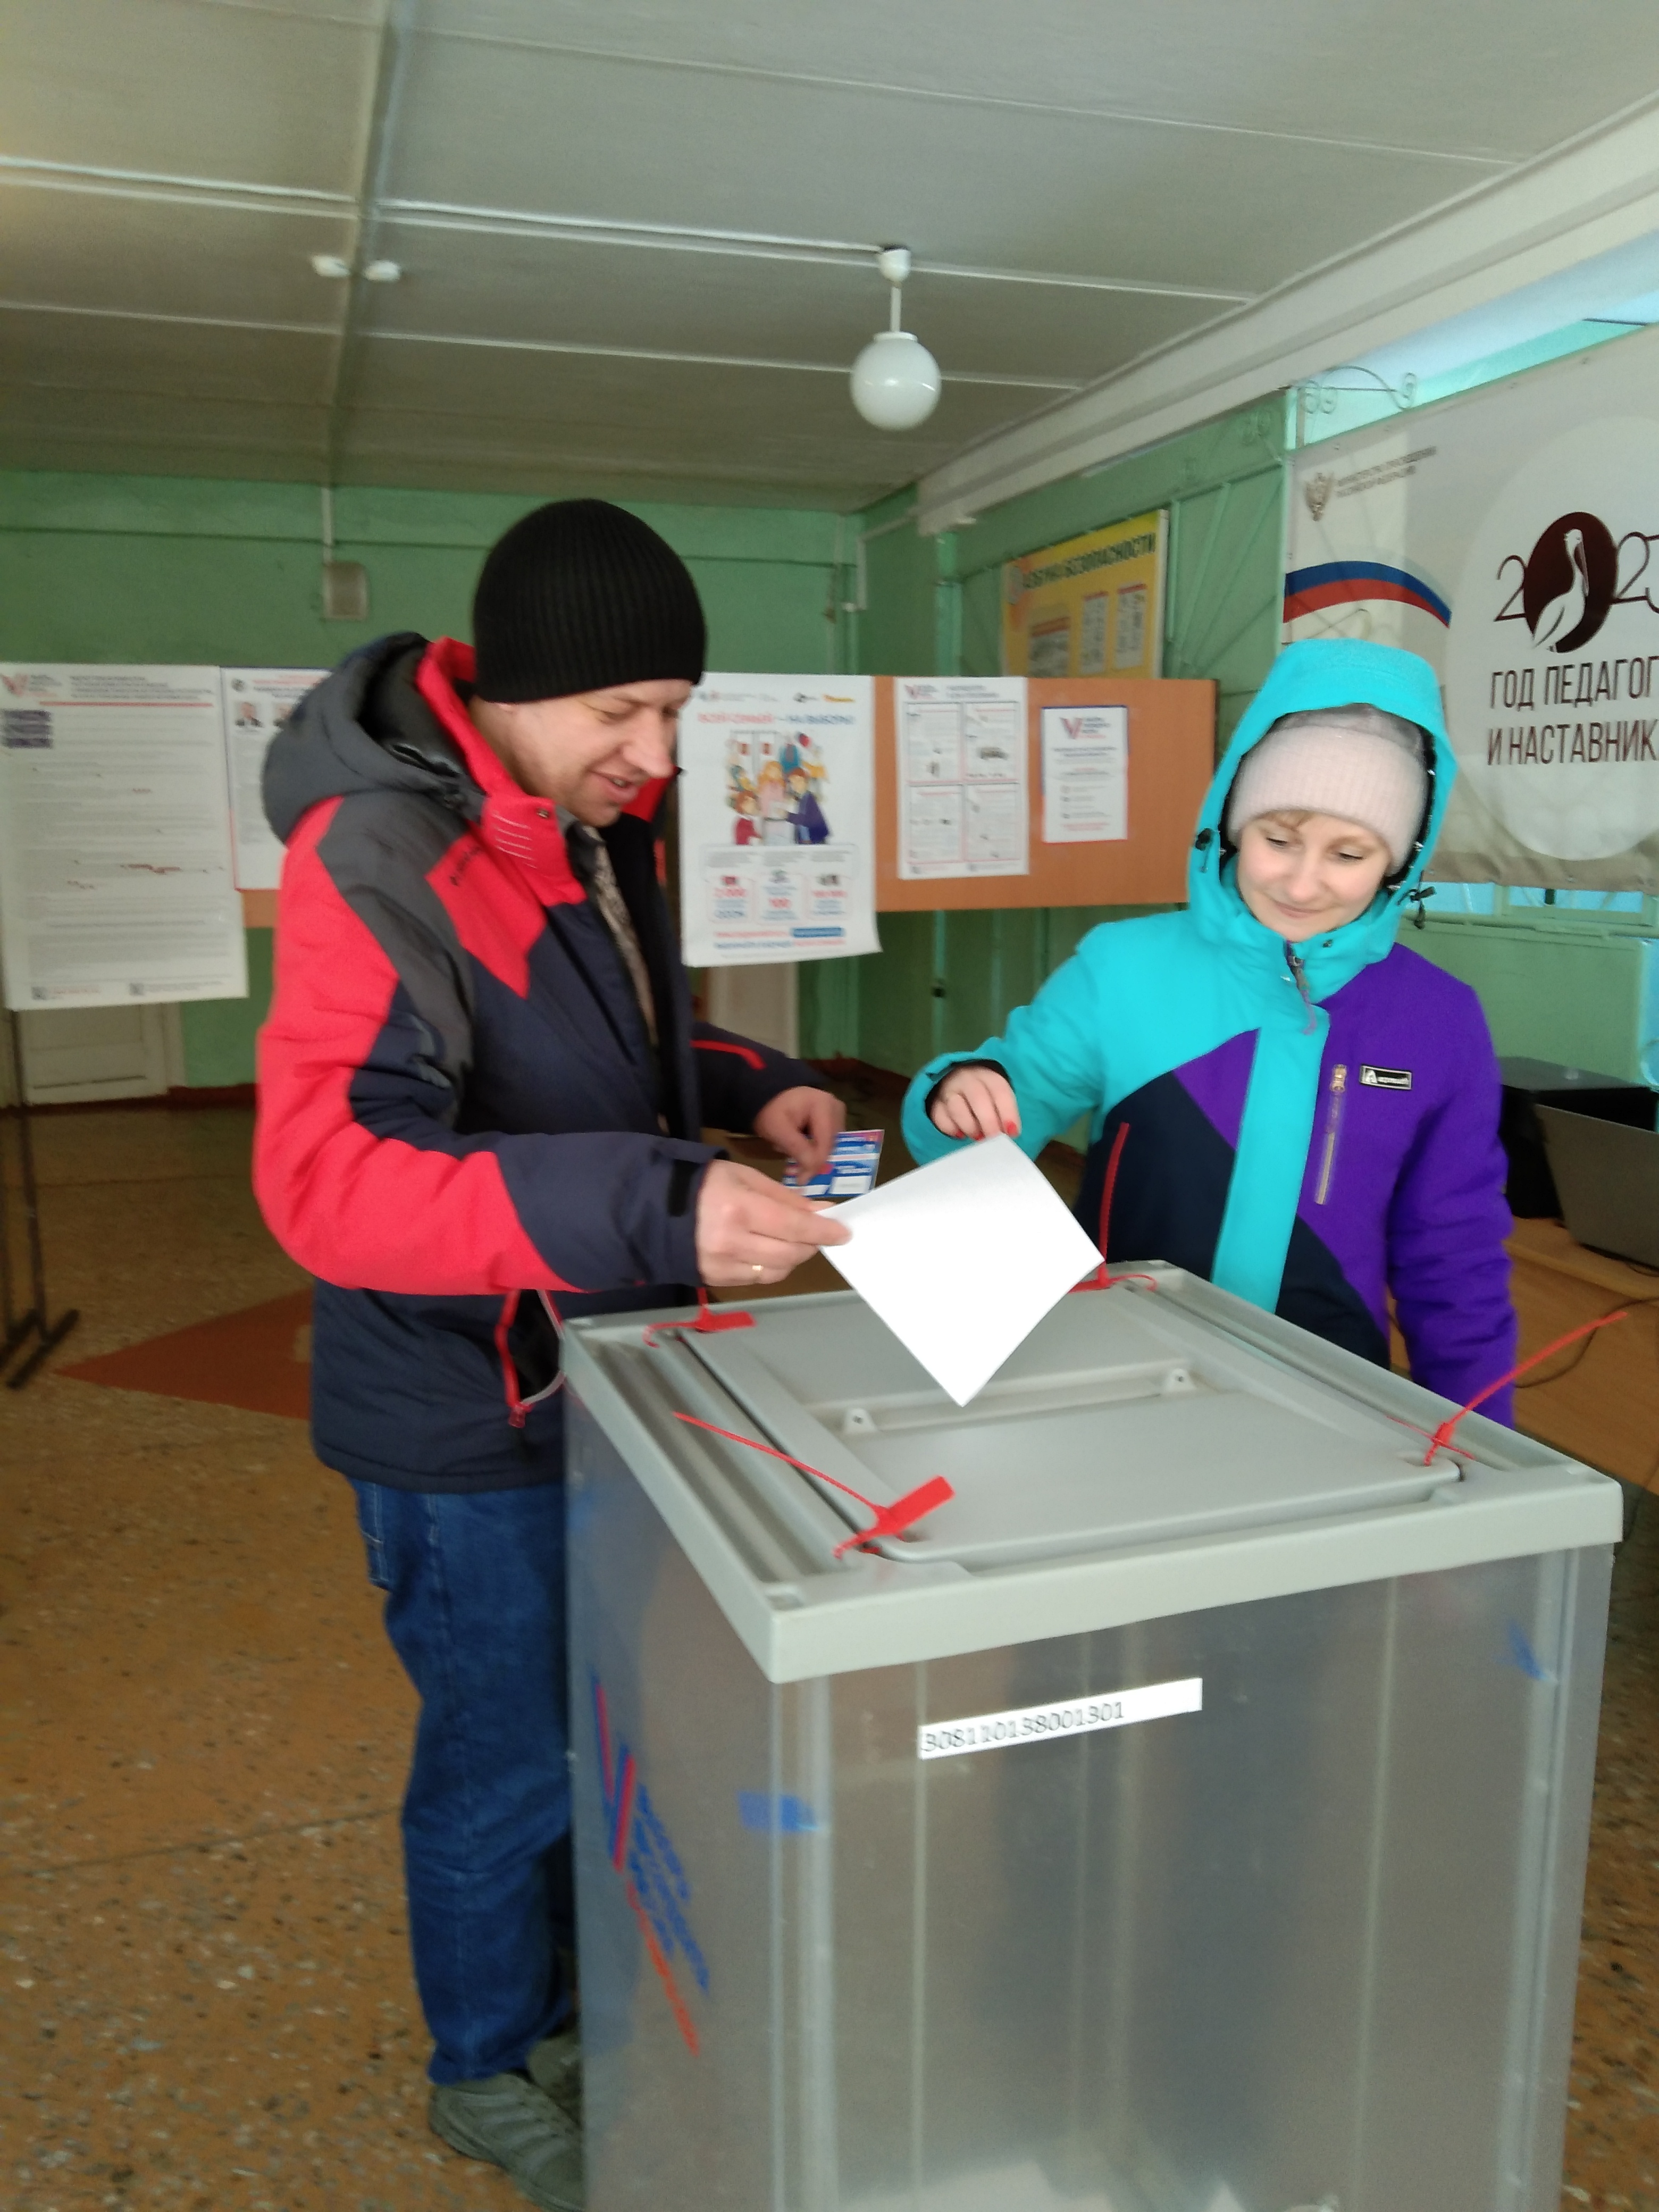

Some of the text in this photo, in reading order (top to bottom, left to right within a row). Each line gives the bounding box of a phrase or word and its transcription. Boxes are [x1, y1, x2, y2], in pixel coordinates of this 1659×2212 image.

[1490, 668, 1535, 711] ГОД
[1487, 719, 1659, 766] И НАСТАВНИК
[921, 1702, 1124, 1752] 308110138001301
